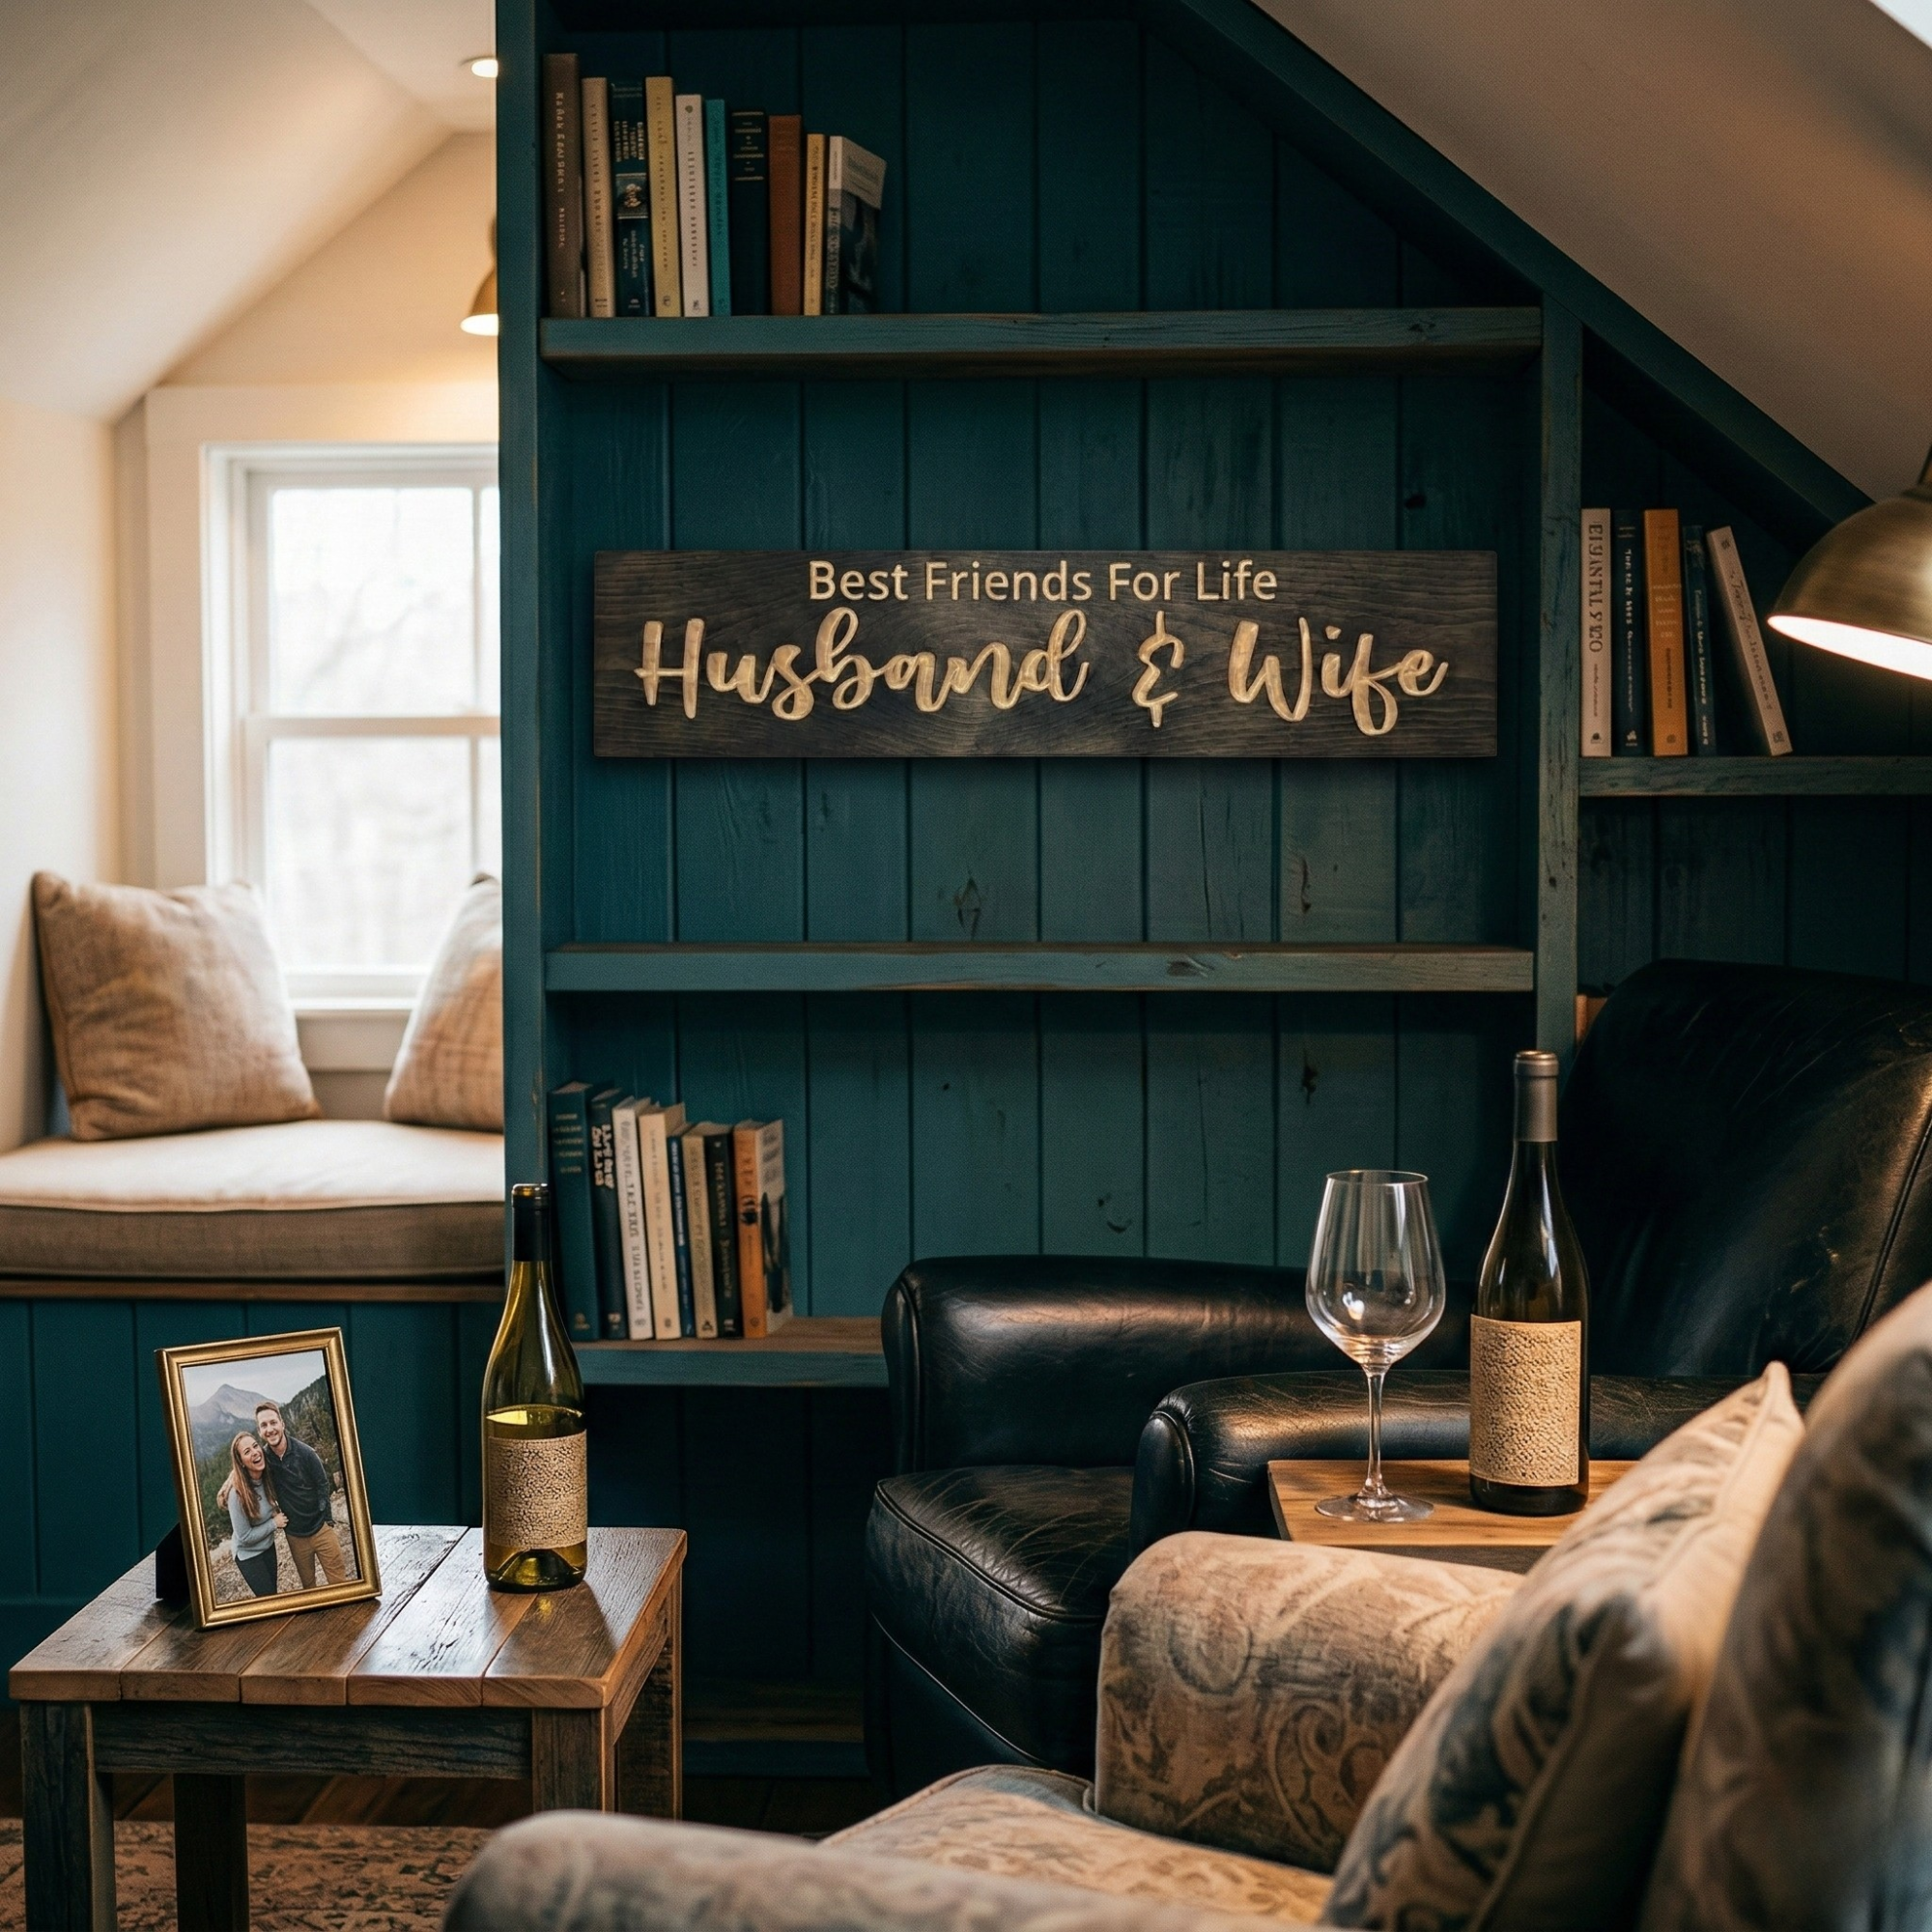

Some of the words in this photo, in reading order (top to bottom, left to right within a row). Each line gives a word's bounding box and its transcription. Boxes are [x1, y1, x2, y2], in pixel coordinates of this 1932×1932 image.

[810, 560, 909, 601] Best
[925, 559, 1093, 602] Friends
[1109, 562, 1180, 602] For
[1197, 559, 1278, 601] Life
[635, 607, 1090, 721] Husband
[1132, 610, 1184, 728] &
[1228, 617, 1449, 736] Wife
